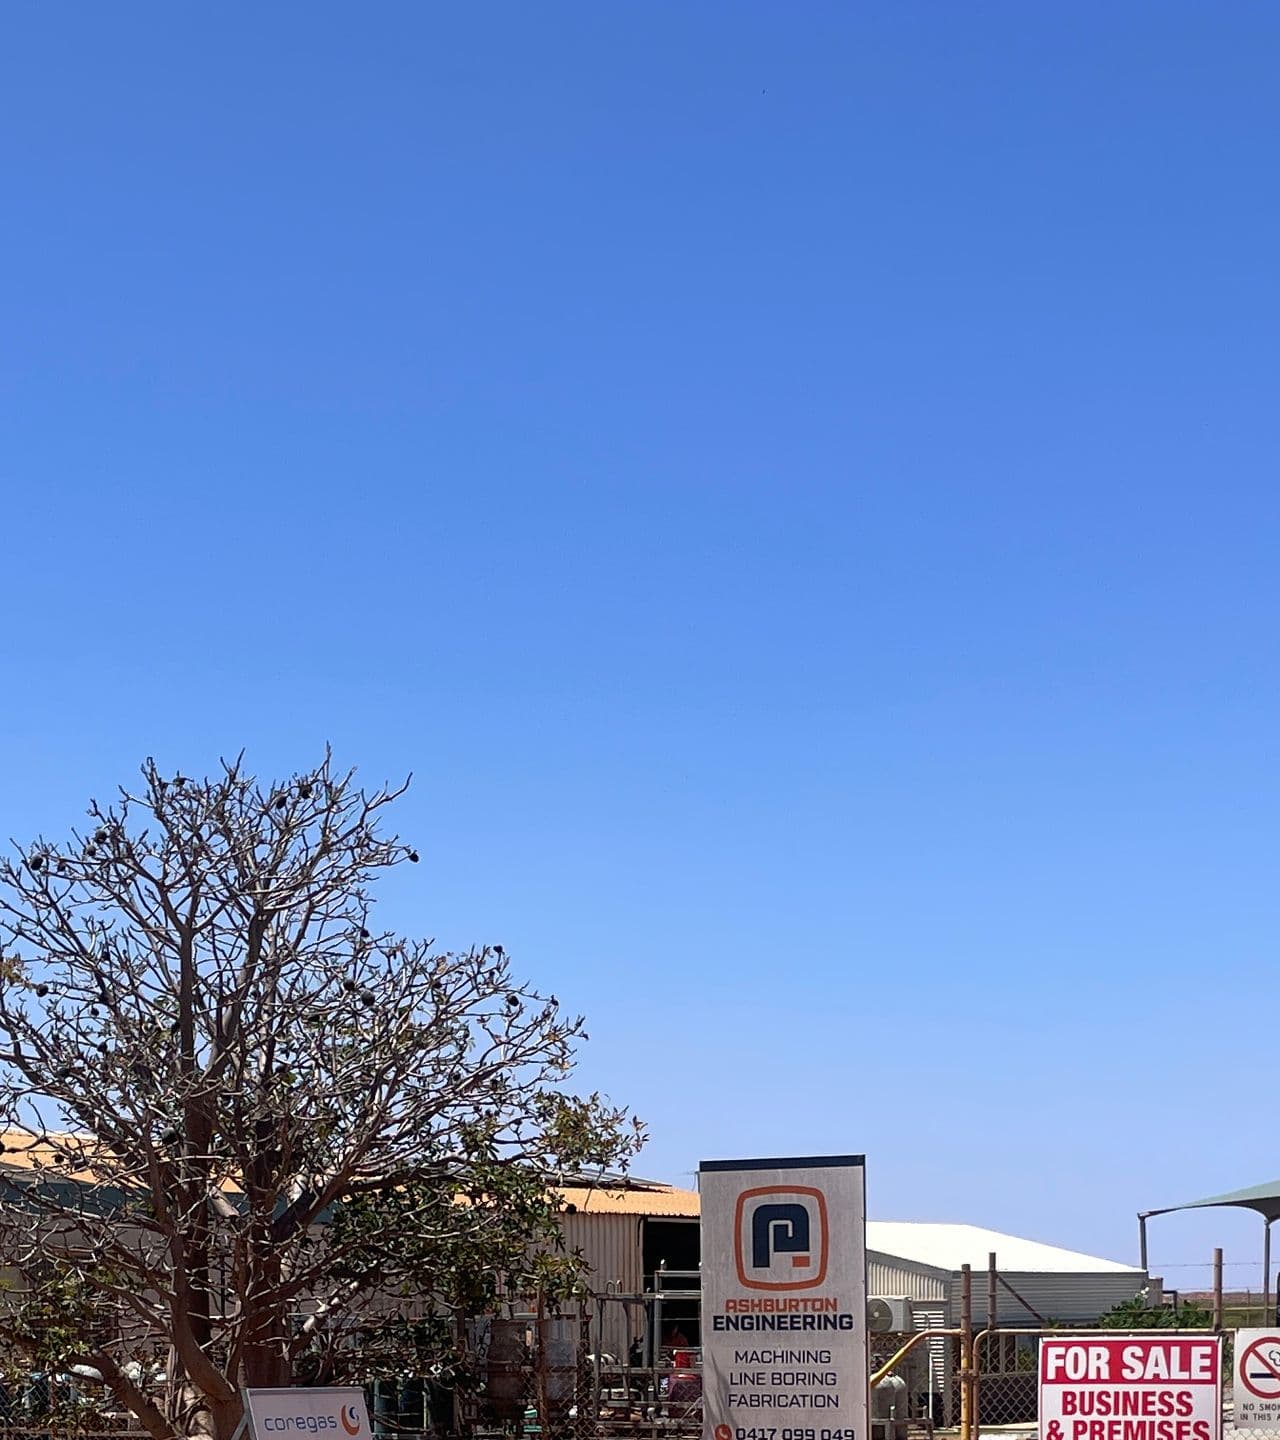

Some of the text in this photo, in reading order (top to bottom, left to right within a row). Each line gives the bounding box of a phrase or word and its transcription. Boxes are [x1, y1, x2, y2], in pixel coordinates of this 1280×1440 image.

[725, 1298, 837, 1313] ASHBURTON
[713, 1314, 853, 1331] ENGINEERING
[735, 1350, 832, 1364] MACHINING
[1046, 1346, 1212, 1380] FOR SALE
[730, 1372, 837, 1386] LINE BORING
[728, 1394, 839, 1408] FABRICATION
[1062, 1391, 1193, 1417] BUSINESS
[1242, 1403, 1254, 1411] NO
[264, 1415, 337, 1433] coregas
[1253, 1413, 1271, 1421] THIS
[736, 1428, 777, 1440] 0417
